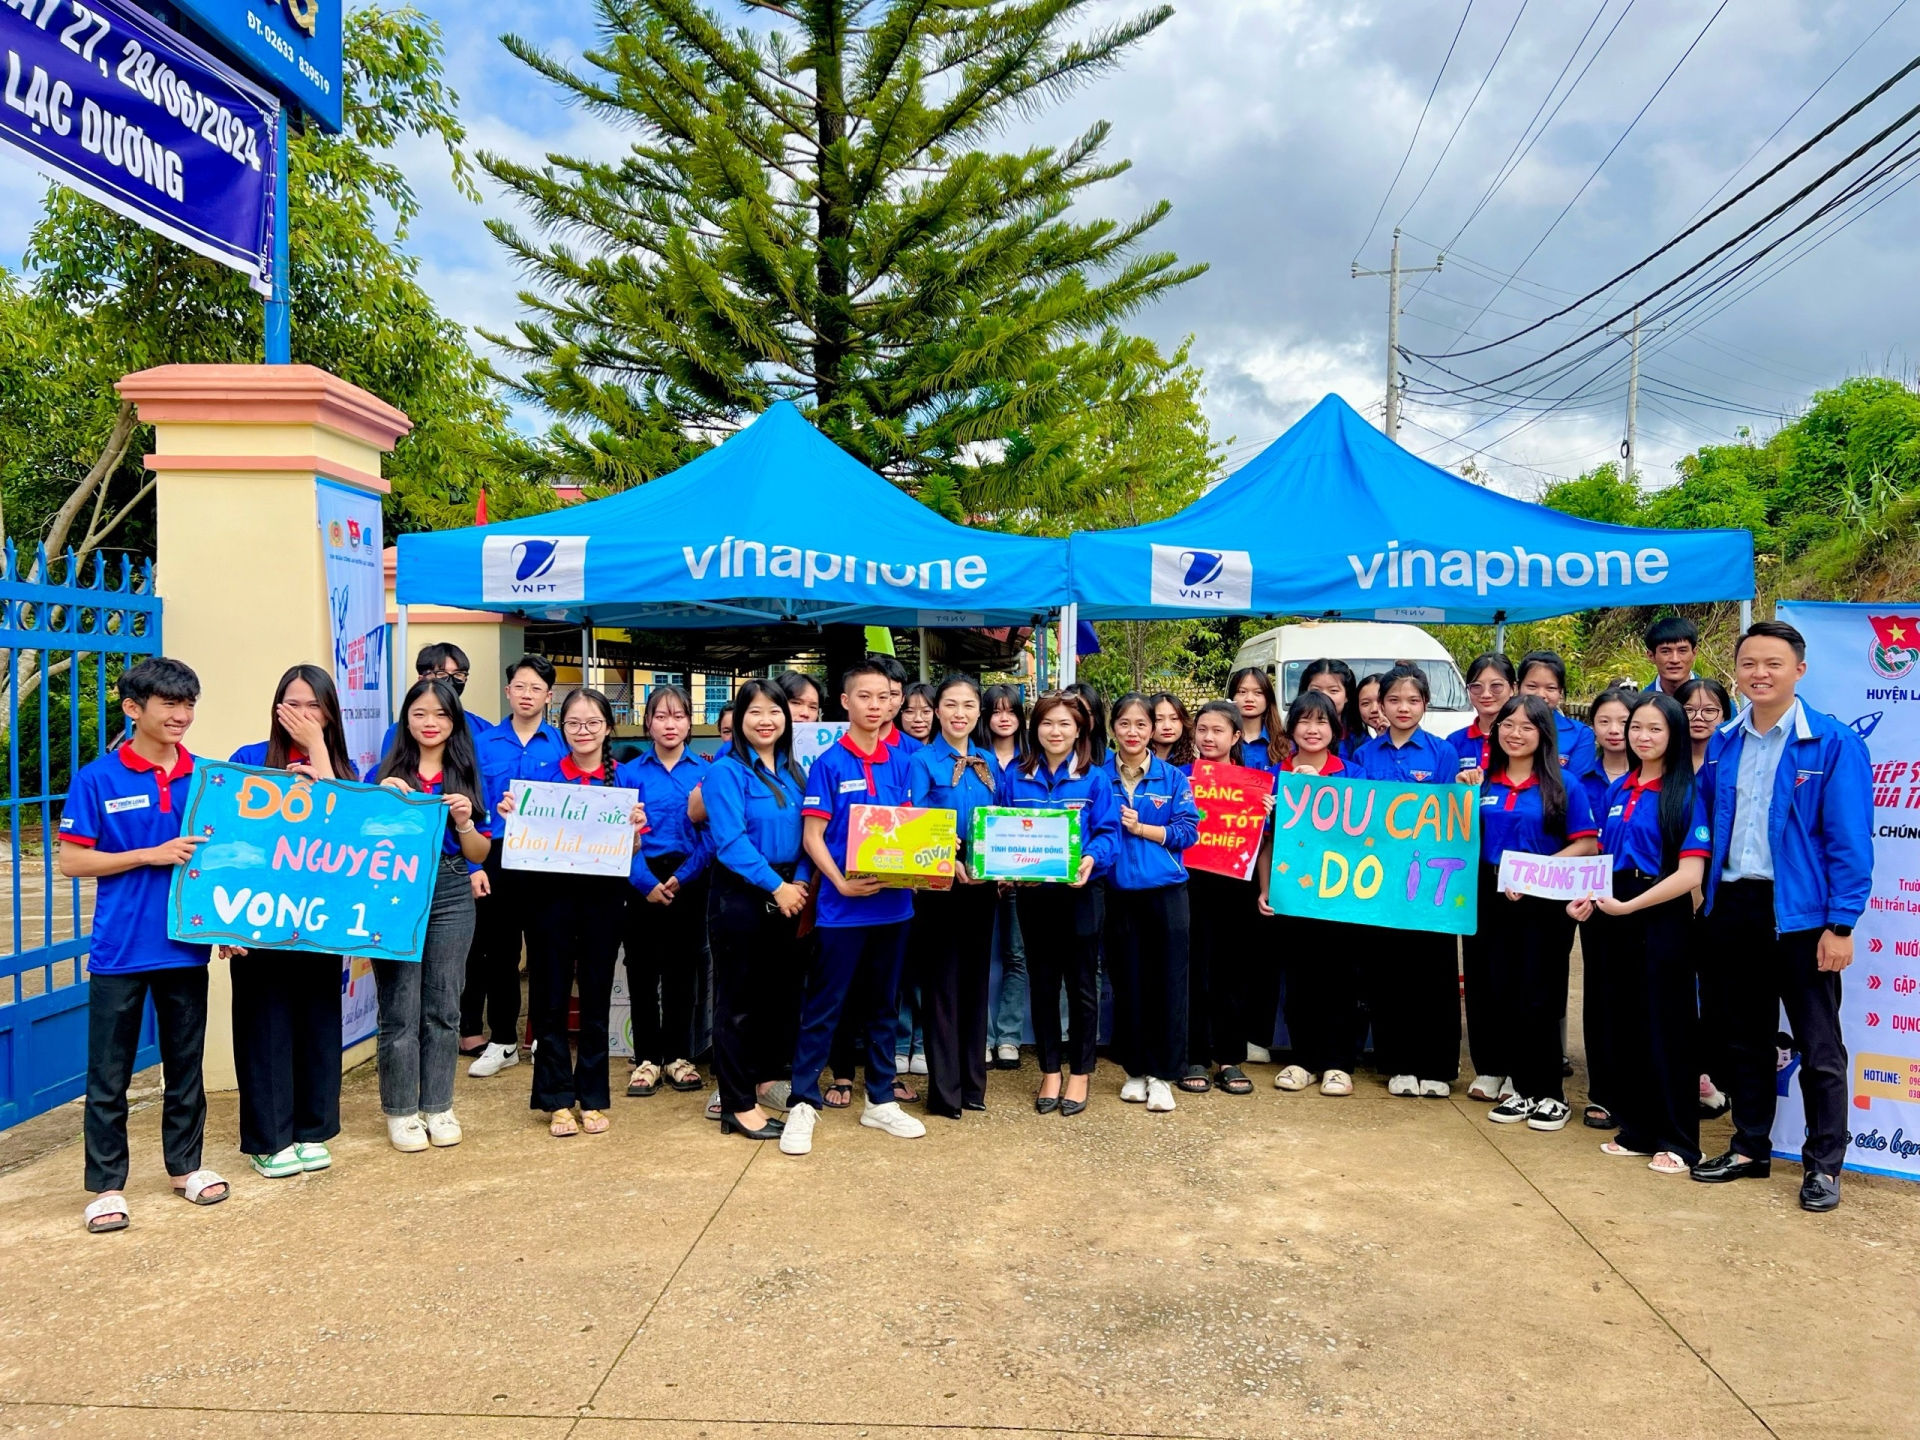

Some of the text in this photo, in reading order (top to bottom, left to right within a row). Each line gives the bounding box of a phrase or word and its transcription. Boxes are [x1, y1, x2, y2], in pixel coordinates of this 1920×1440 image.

[264, 25, 294, 63] 02633
[298, 55, 330, 95] 839519
[116, 39, 261, 172] 28/06/2024
[4, 49, 184, 202] LẠC DƯƠNG
[1347, 540, 1669, 595] vinaphone
[511, 584, 557, 592] VNPT
[1179, 589, 1224, 599] VNPT
[1866, 685, 1908, 704] HUYỆN
[1872, 784, 1902, 807] ÙA
[1220, 806, 1264, 829] TỐT
[1282, 783, 1473, 842] YOU CAN
[1879, 823, 1920, 839] CHÚN
[271, 834, 420, 889] NGUYỆN
[1318, 850, 1384, 900] DO
[212, 884, 370, 940] VỌNG 1
[1870, 896, 1883, 913] thị
[1885, 896, 1905, 911] trấn
[1893, 974, 1917, 996] GẶP
[1863, 1068, 1902, 1085] HOTLINE:
[1855, 1128, 1887, 1151] các
